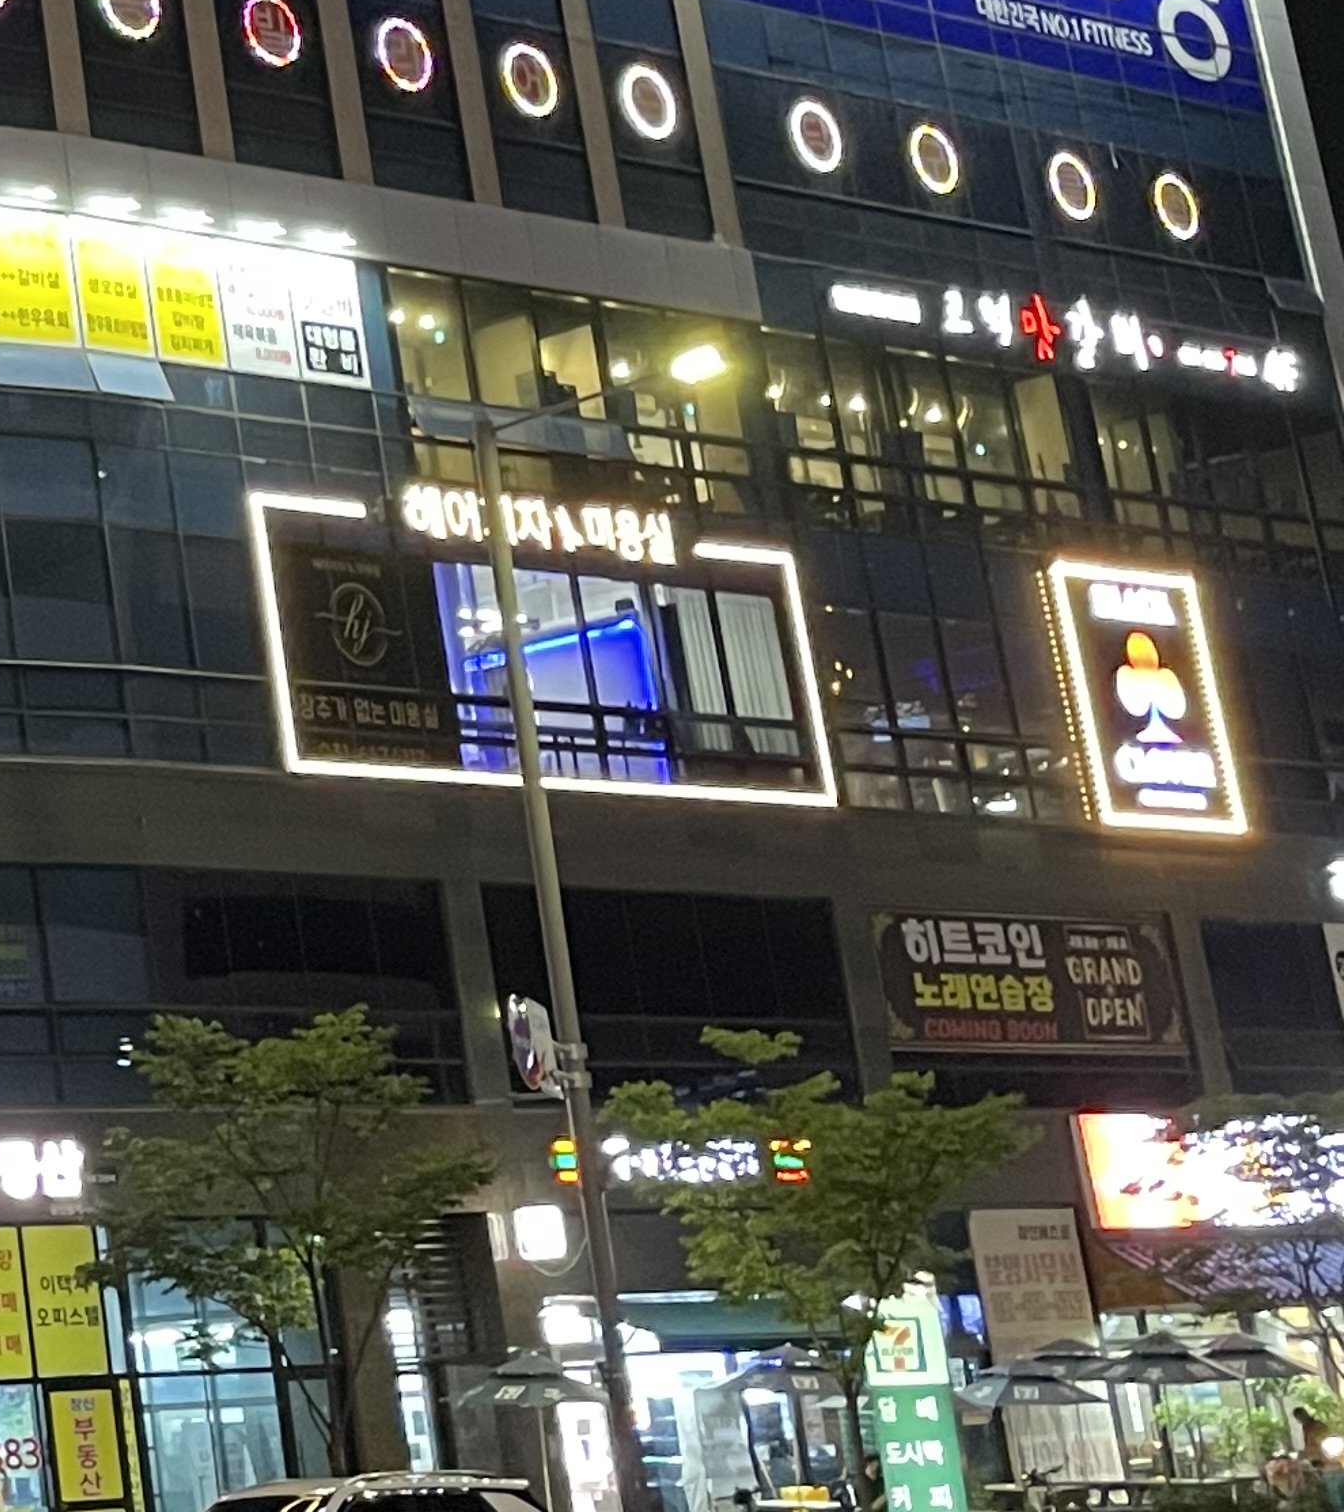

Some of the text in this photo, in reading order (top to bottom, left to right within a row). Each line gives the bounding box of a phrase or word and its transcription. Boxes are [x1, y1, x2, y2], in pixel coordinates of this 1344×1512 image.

[900, 918, 1047, 969] 히트코인
[1064, 955, 1143, 986] GRAND
[913, 972, 1055, 1013] 노래연습장
[1085, 992, 1144, 1027] OPEN
[36, 1305, 100, 1327] 오피스텔
[74, 1417, 103, 1498] 부동산
